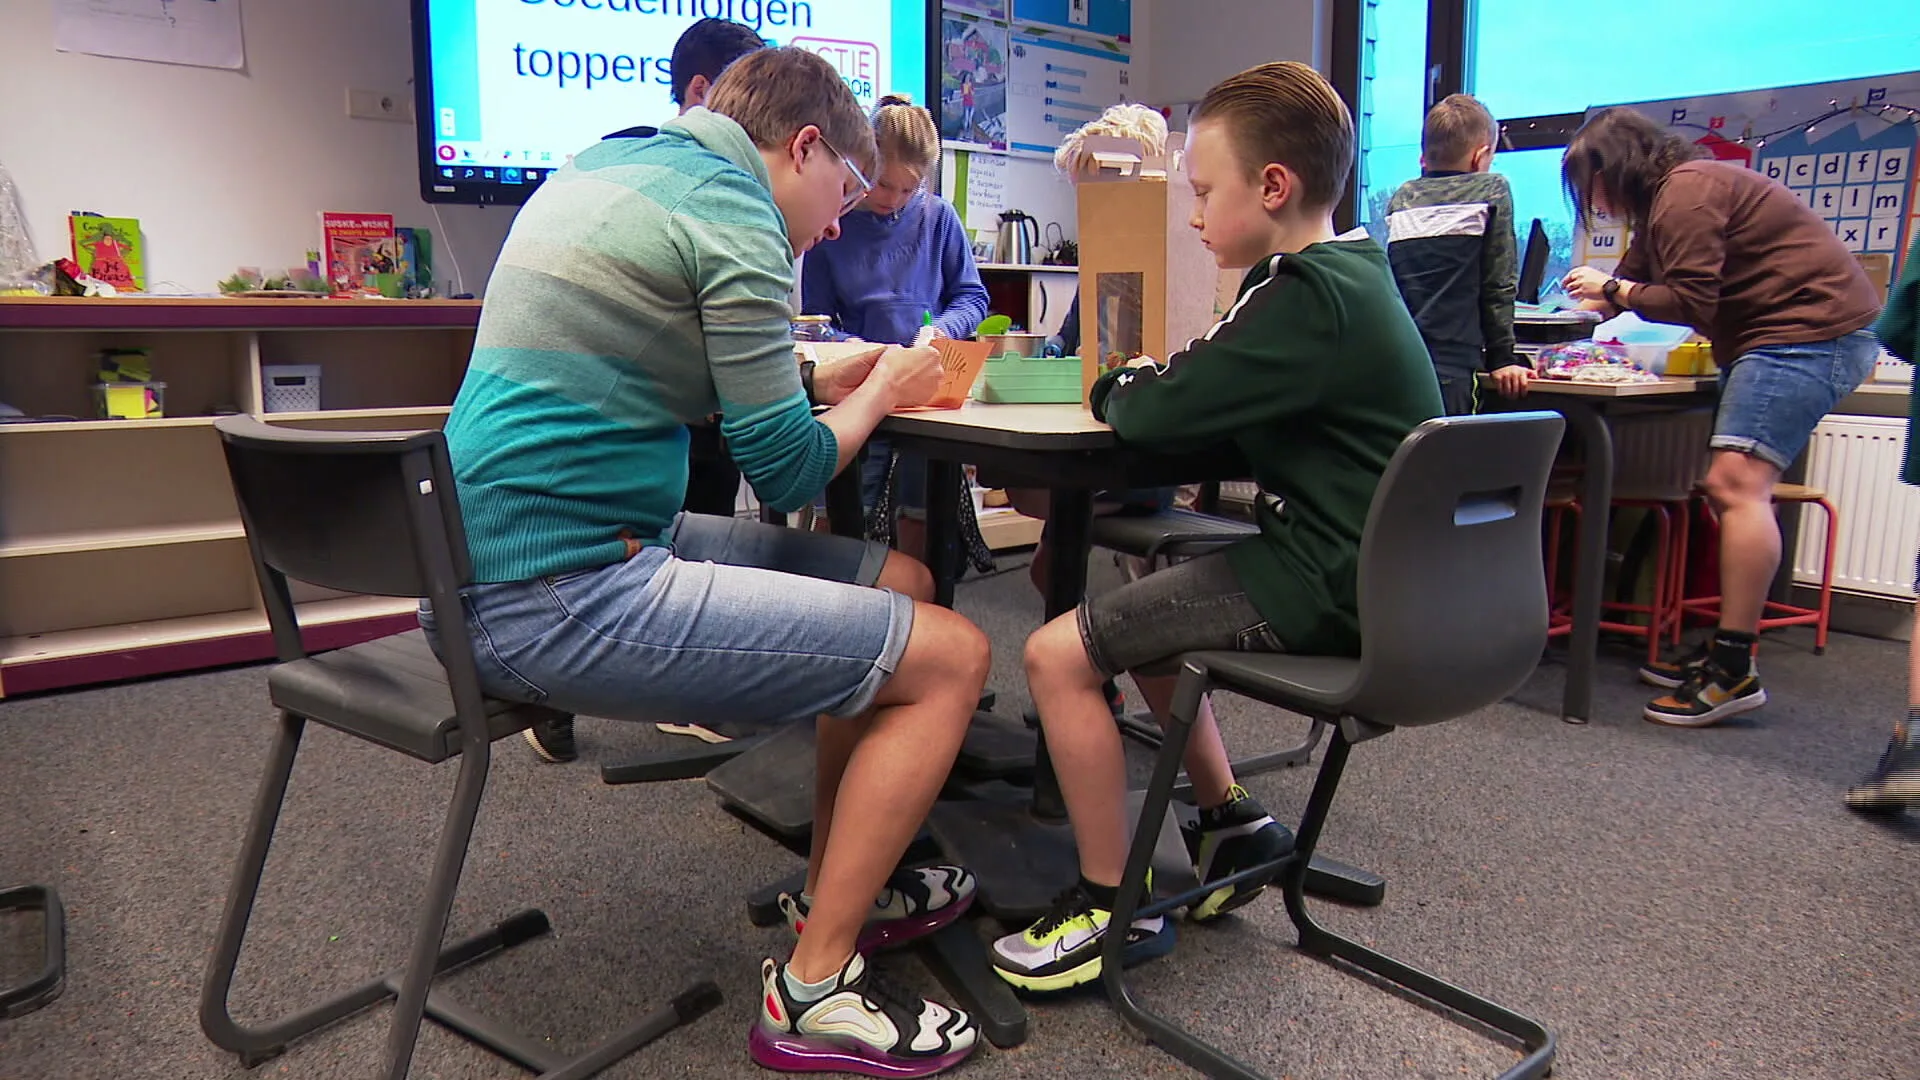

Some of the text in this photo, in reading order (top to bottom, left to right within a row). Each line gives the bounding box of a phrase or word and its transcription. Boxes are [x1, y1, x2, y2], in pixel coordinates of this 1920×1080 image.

[513, 43, 672, 90] toppers
[1767, 153, 1901, 179] b c d f g
[1822, 192, 1832, 208] t
[1875, 195, 1898, 209] m
[1593, 235, 1615, 248] uu
[1843, 226, 1888, 242] x r
